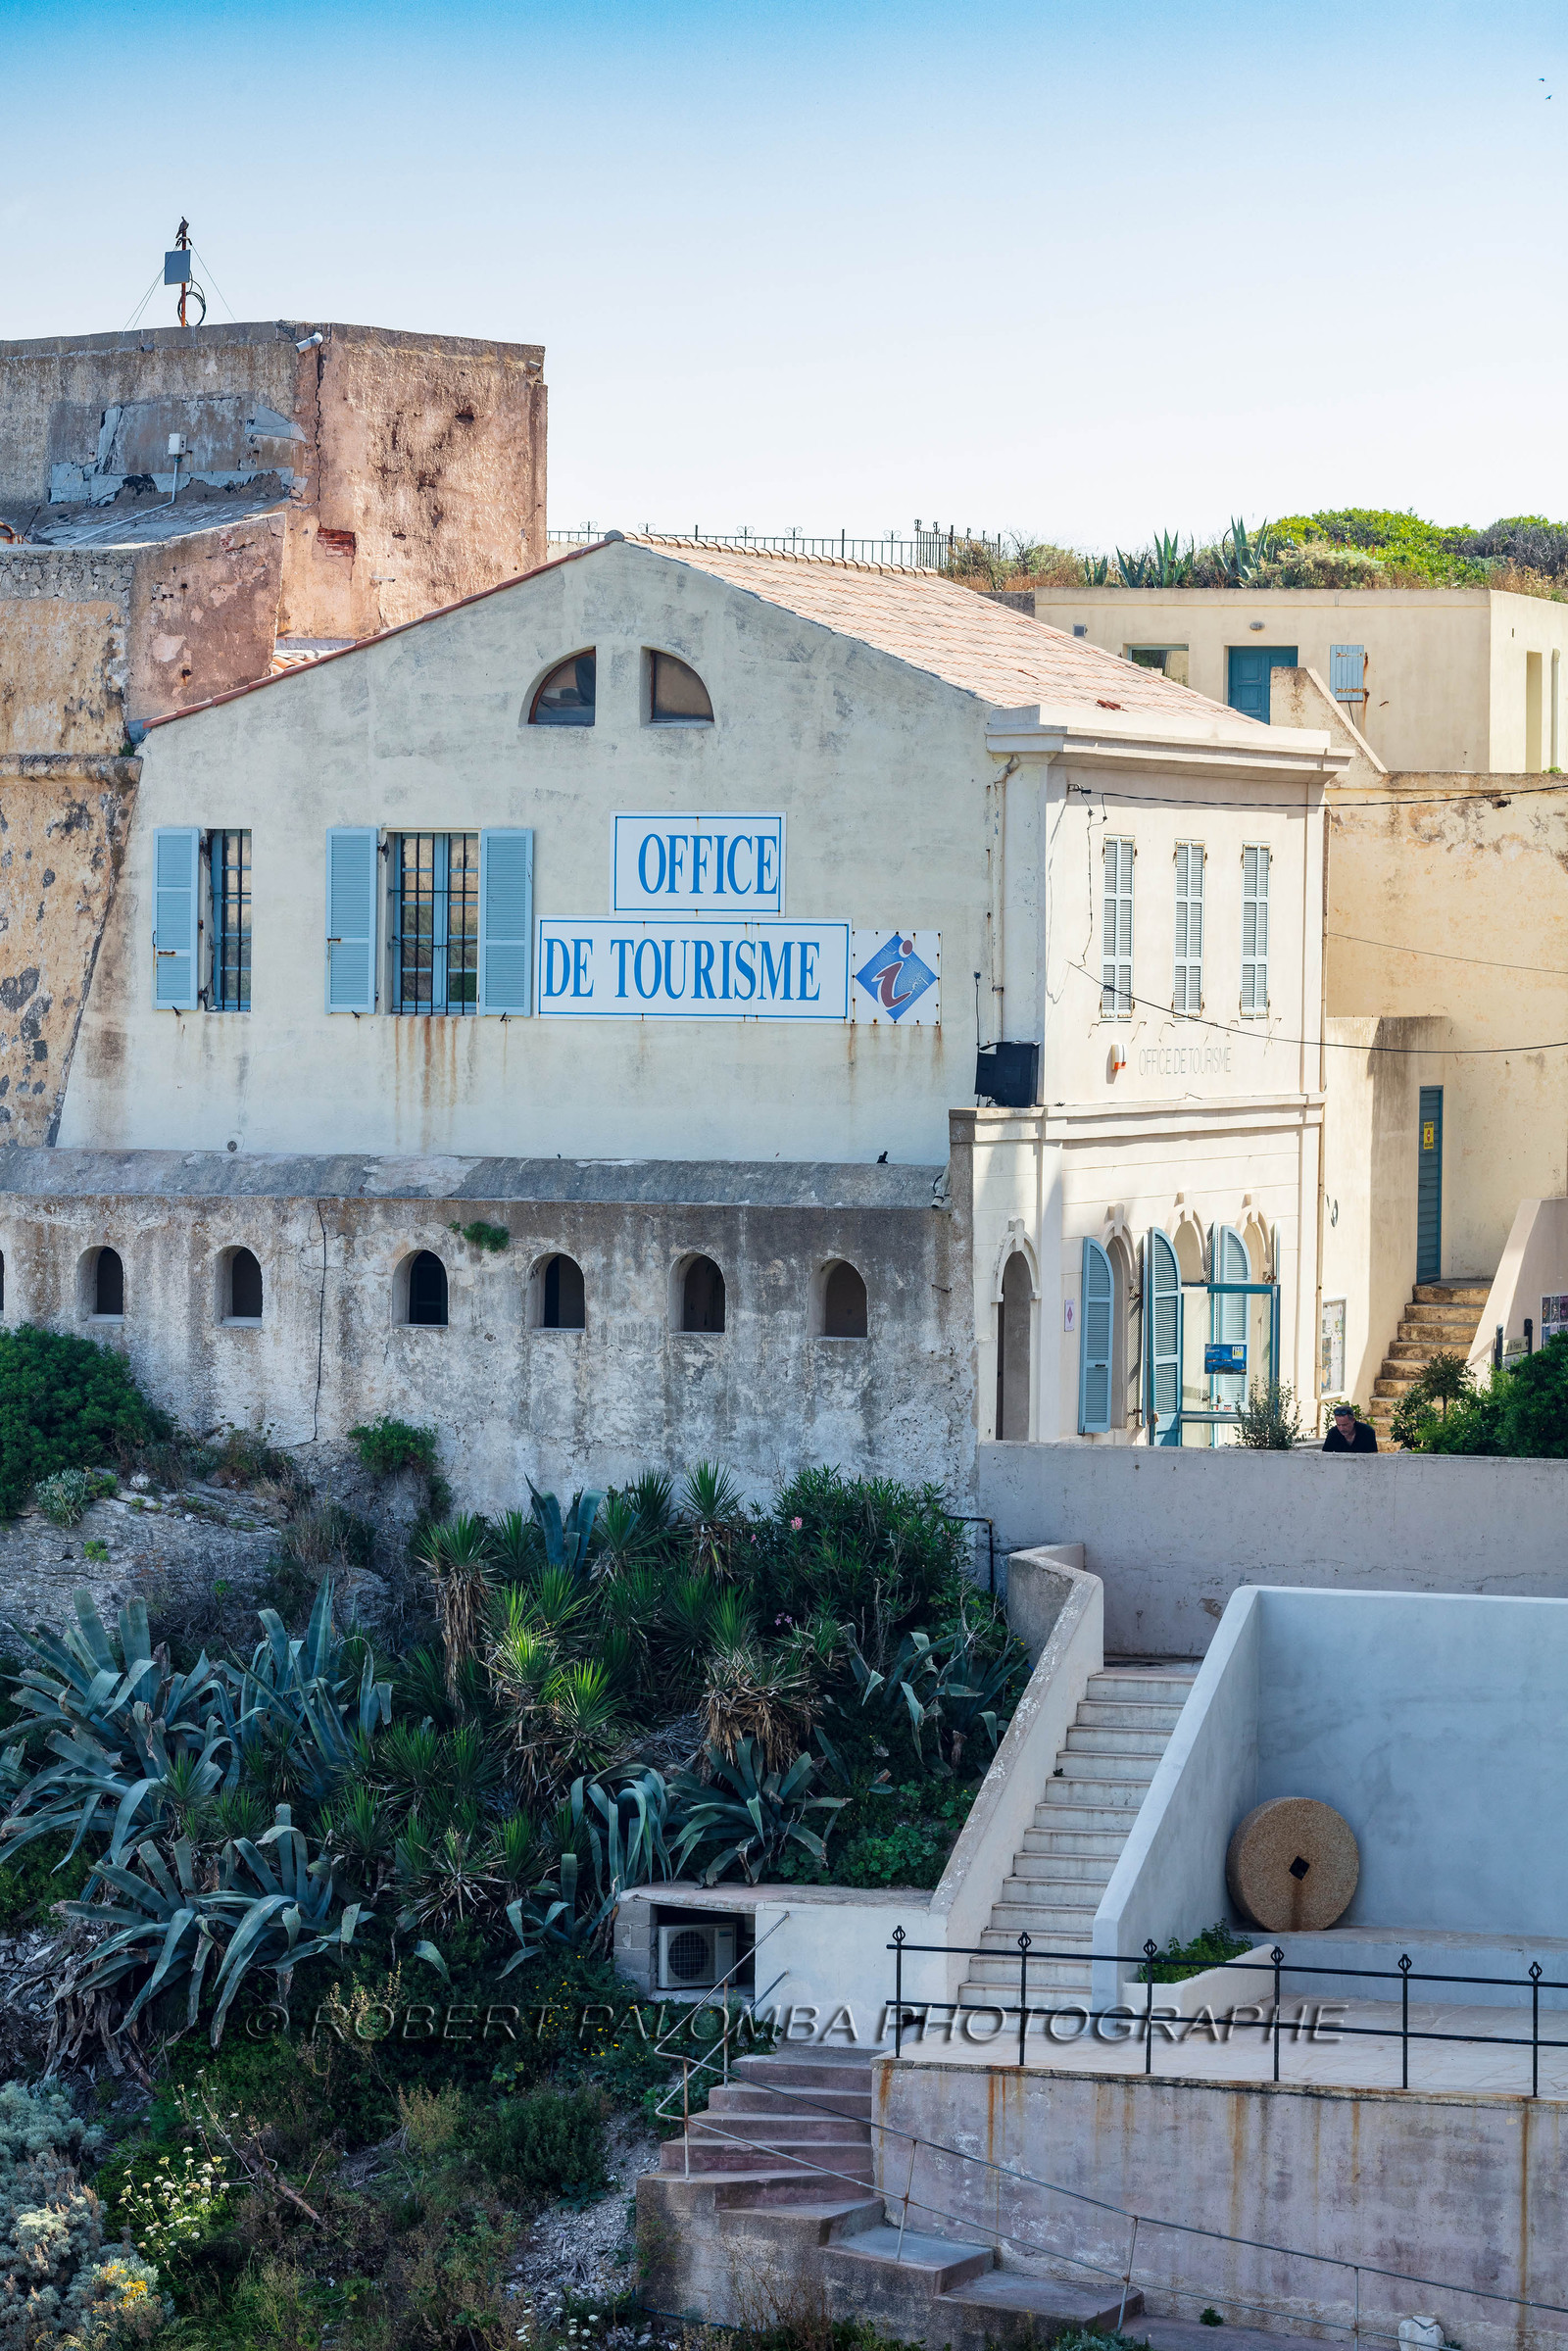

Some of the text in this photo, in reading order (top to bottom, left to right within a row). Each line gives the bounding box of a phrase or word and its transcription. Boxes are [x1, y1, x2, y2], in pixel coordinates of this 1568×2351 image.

[638, 833, 777, 895] OFFICE
[542, 938, 821, 1001] DE TOURISME
[1139, 1049, 1171, 1075] OFFICE
[1173, 1048, 1186, 1074] DE
